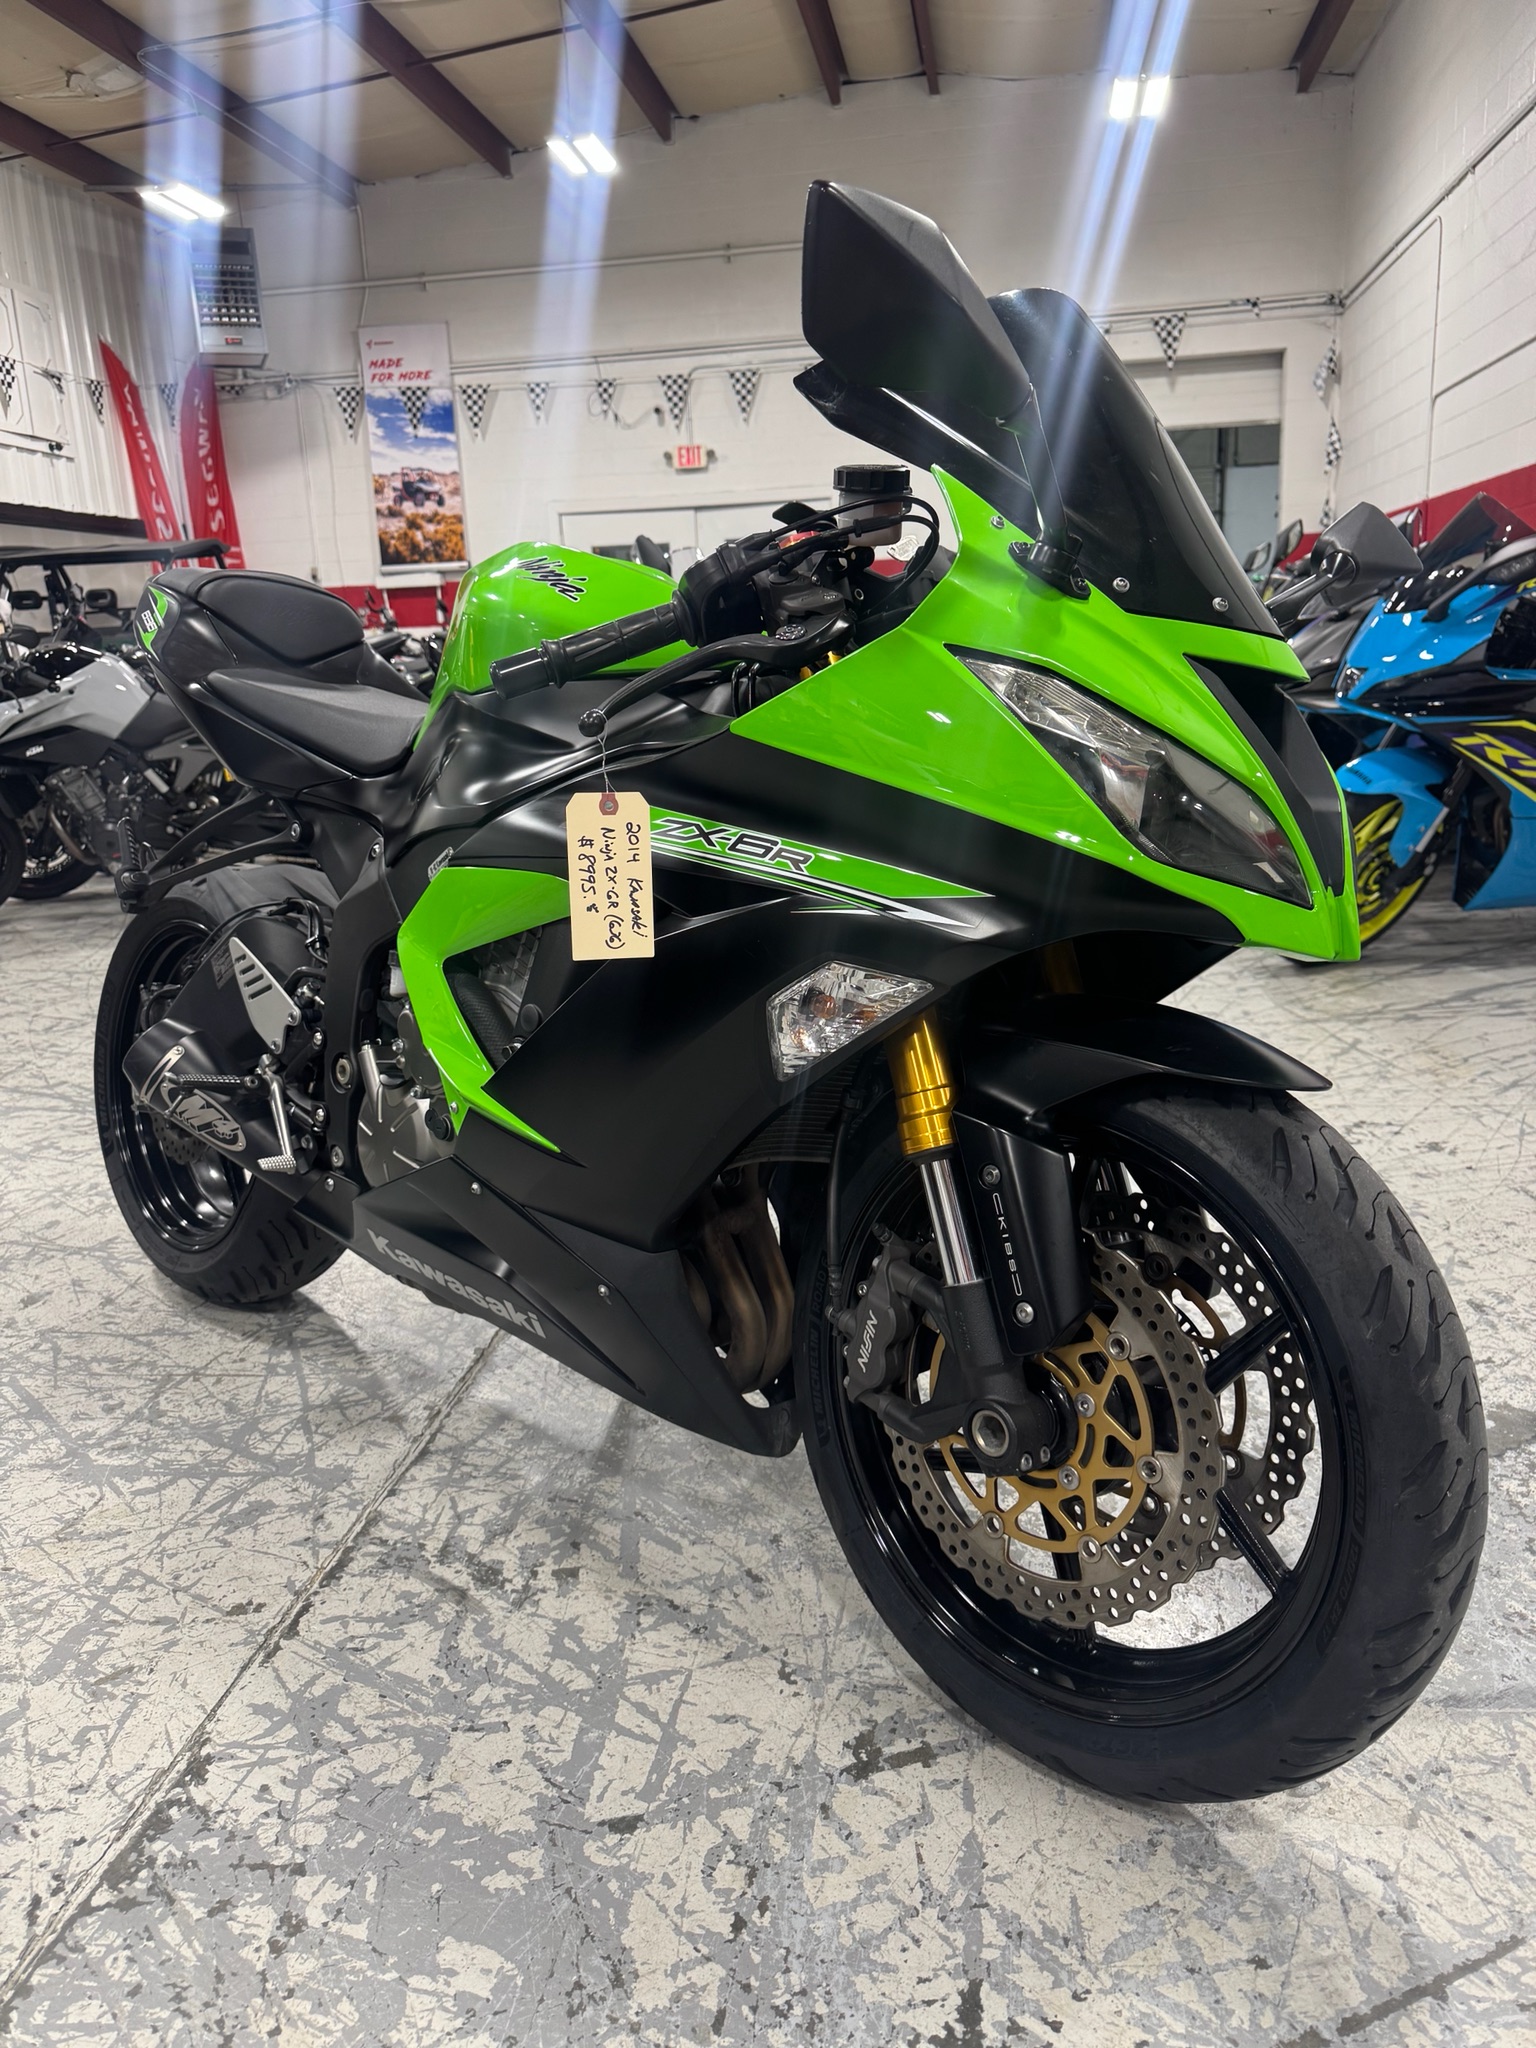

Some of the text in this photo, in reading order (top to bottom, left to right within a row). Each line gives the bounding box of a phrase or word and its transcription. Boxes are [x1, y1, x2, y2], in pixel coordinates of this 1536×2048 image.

[368, 357, 404, 369] MADE
[370, 369, 433, 384] FOR MORE
[677, 445, 702, 468] EXIT
[516, 555, 589, 602] Ninja
[625, 821, 642, 864] 2014
[650, 816, 816, 877] ZX-6R
[366, 1228, 547, 1339] Kawasaki
